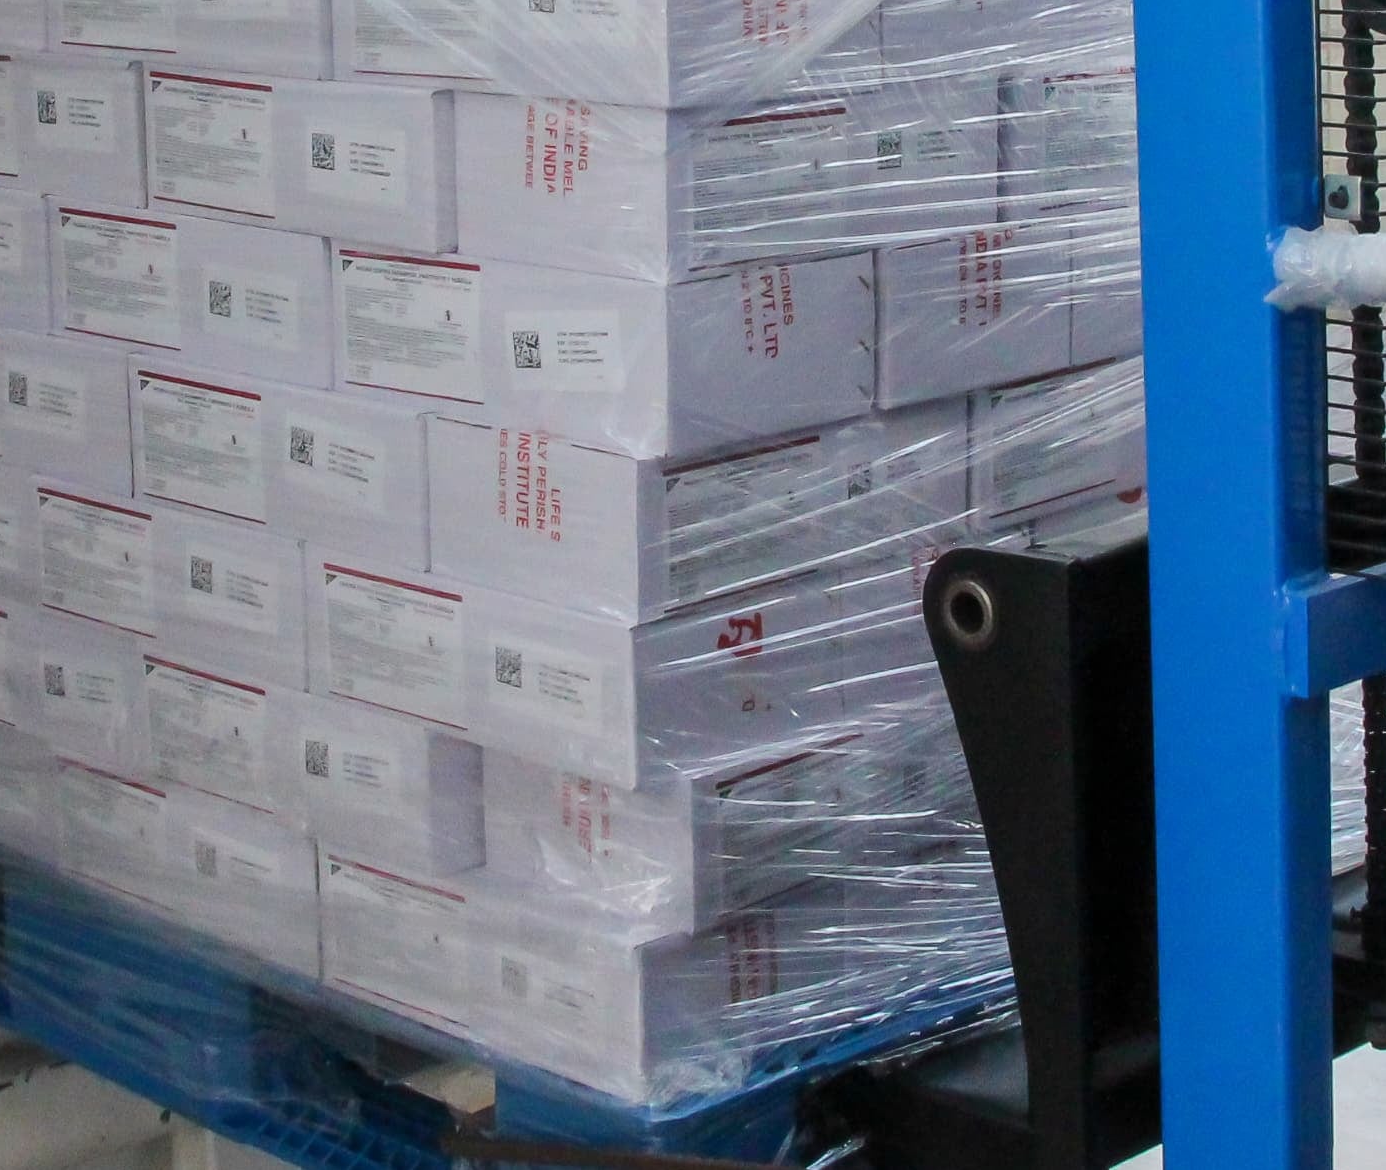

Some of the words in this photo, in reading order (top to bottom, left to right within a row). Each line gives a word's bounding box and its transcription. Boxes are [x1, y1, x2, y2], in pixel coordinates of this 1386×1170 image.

[545, 113, 558, 140] OF
[543, 144, 557, 195] INDIA
[759, 275, 776, 318] PVT.
[499, 452, 507, 487] COLD
[516, 432, 531, 529] INSTITUTE
[551, 488, 561, 526] LIFE
[551, 530, 560, 542] S
